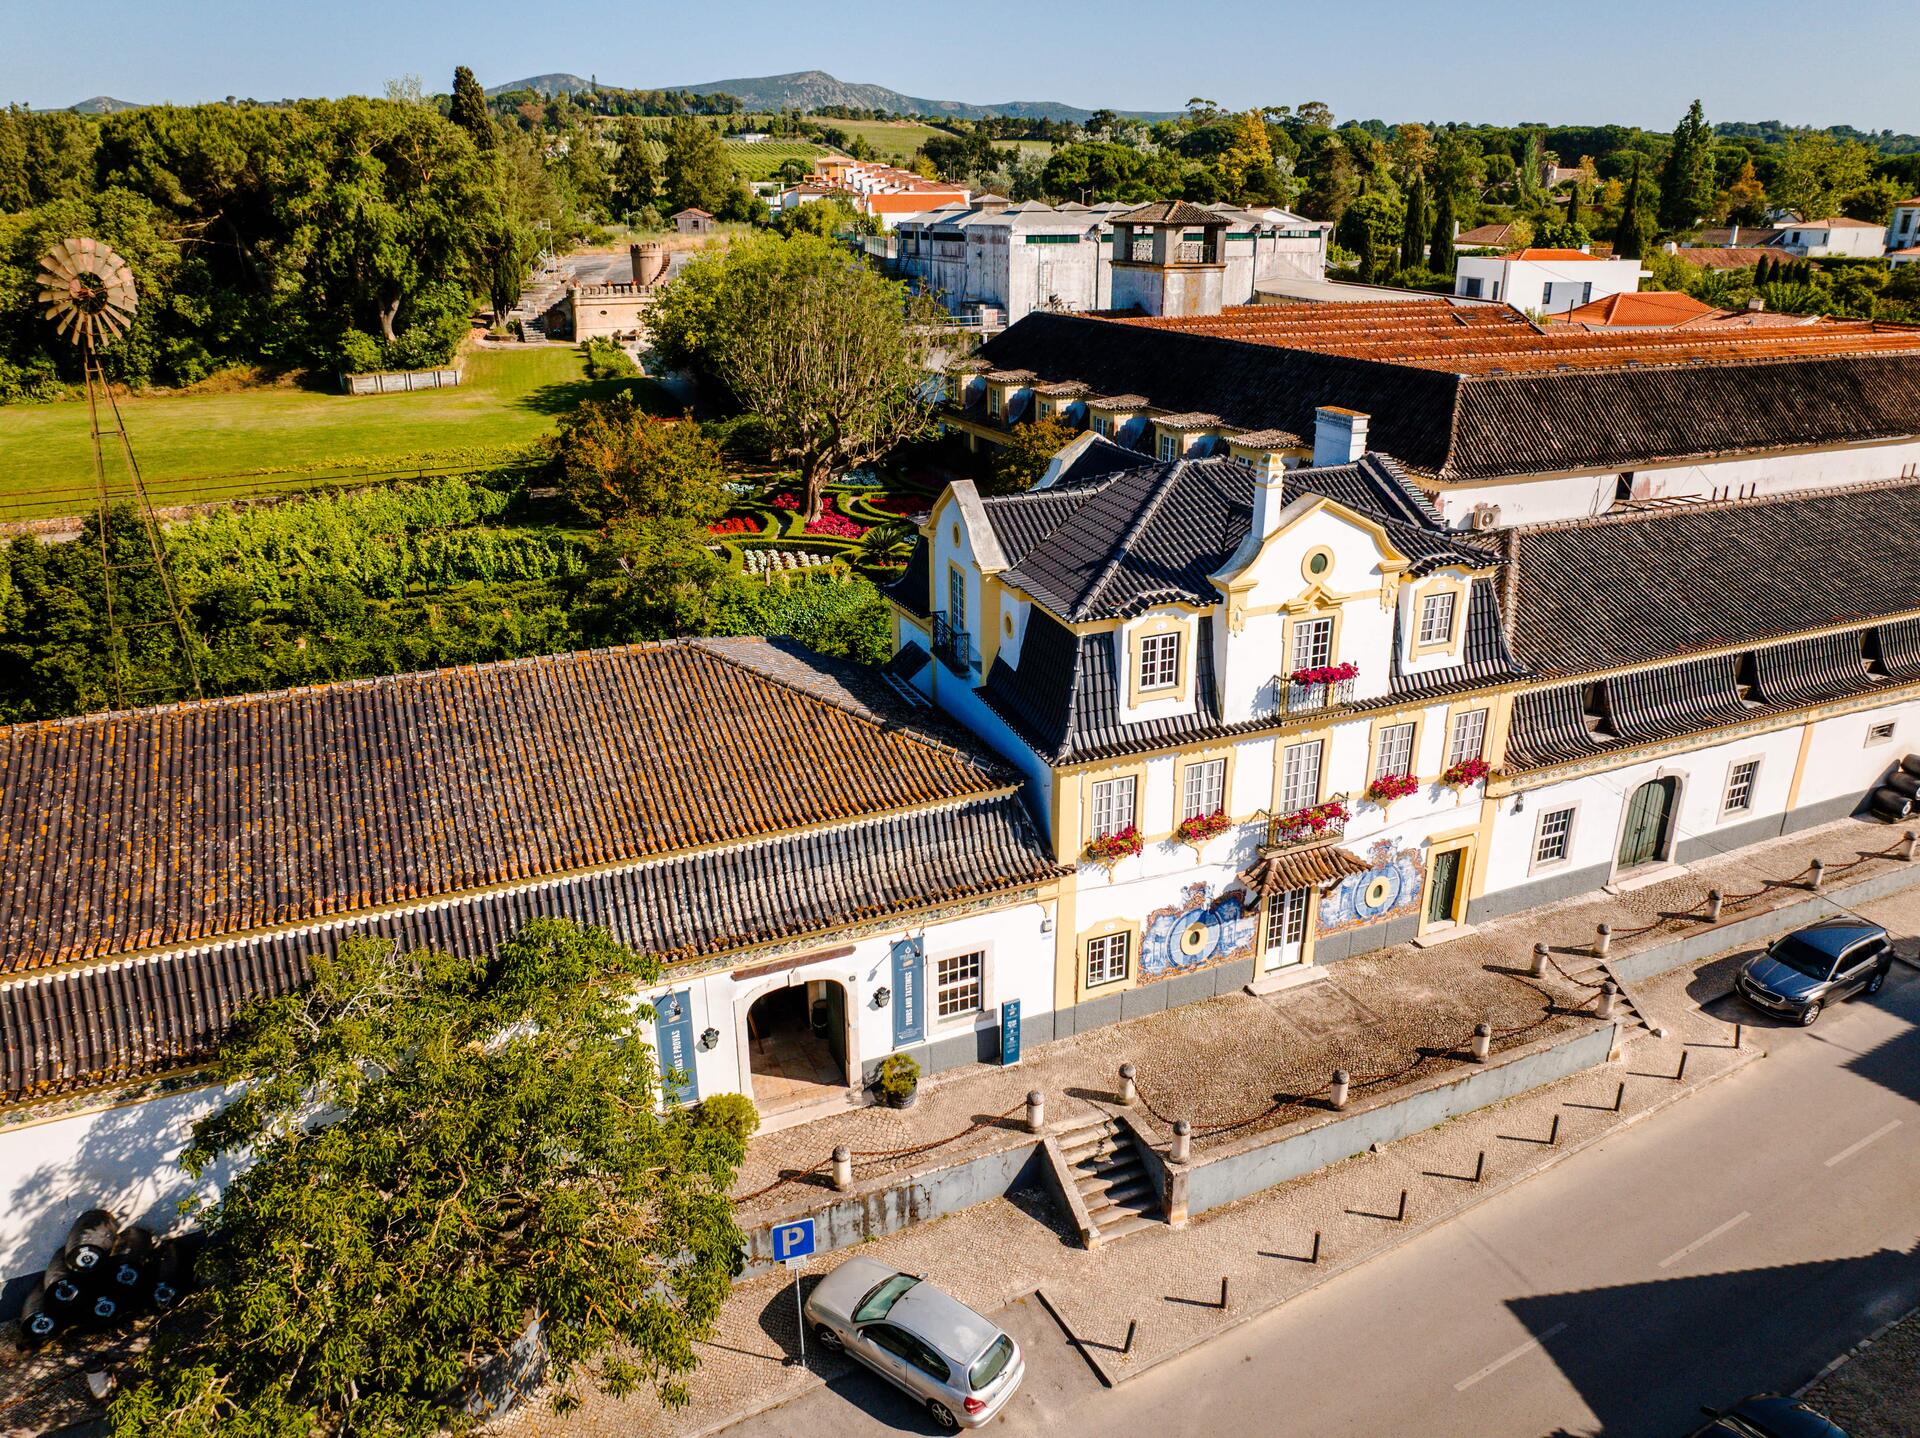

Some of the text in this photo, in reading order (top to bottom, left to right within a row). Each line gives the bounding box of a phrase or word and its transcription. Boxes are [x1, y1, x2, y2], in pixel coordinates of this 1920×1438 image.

[904, 971, 913, 997] TASTINGS
[905, 997, 913, 1008] AND
[905, 1008, 913, 1026] TOURS
[671, 1030, 682, 1054] PROVAS
[782, 1227, 805, 1256] P
